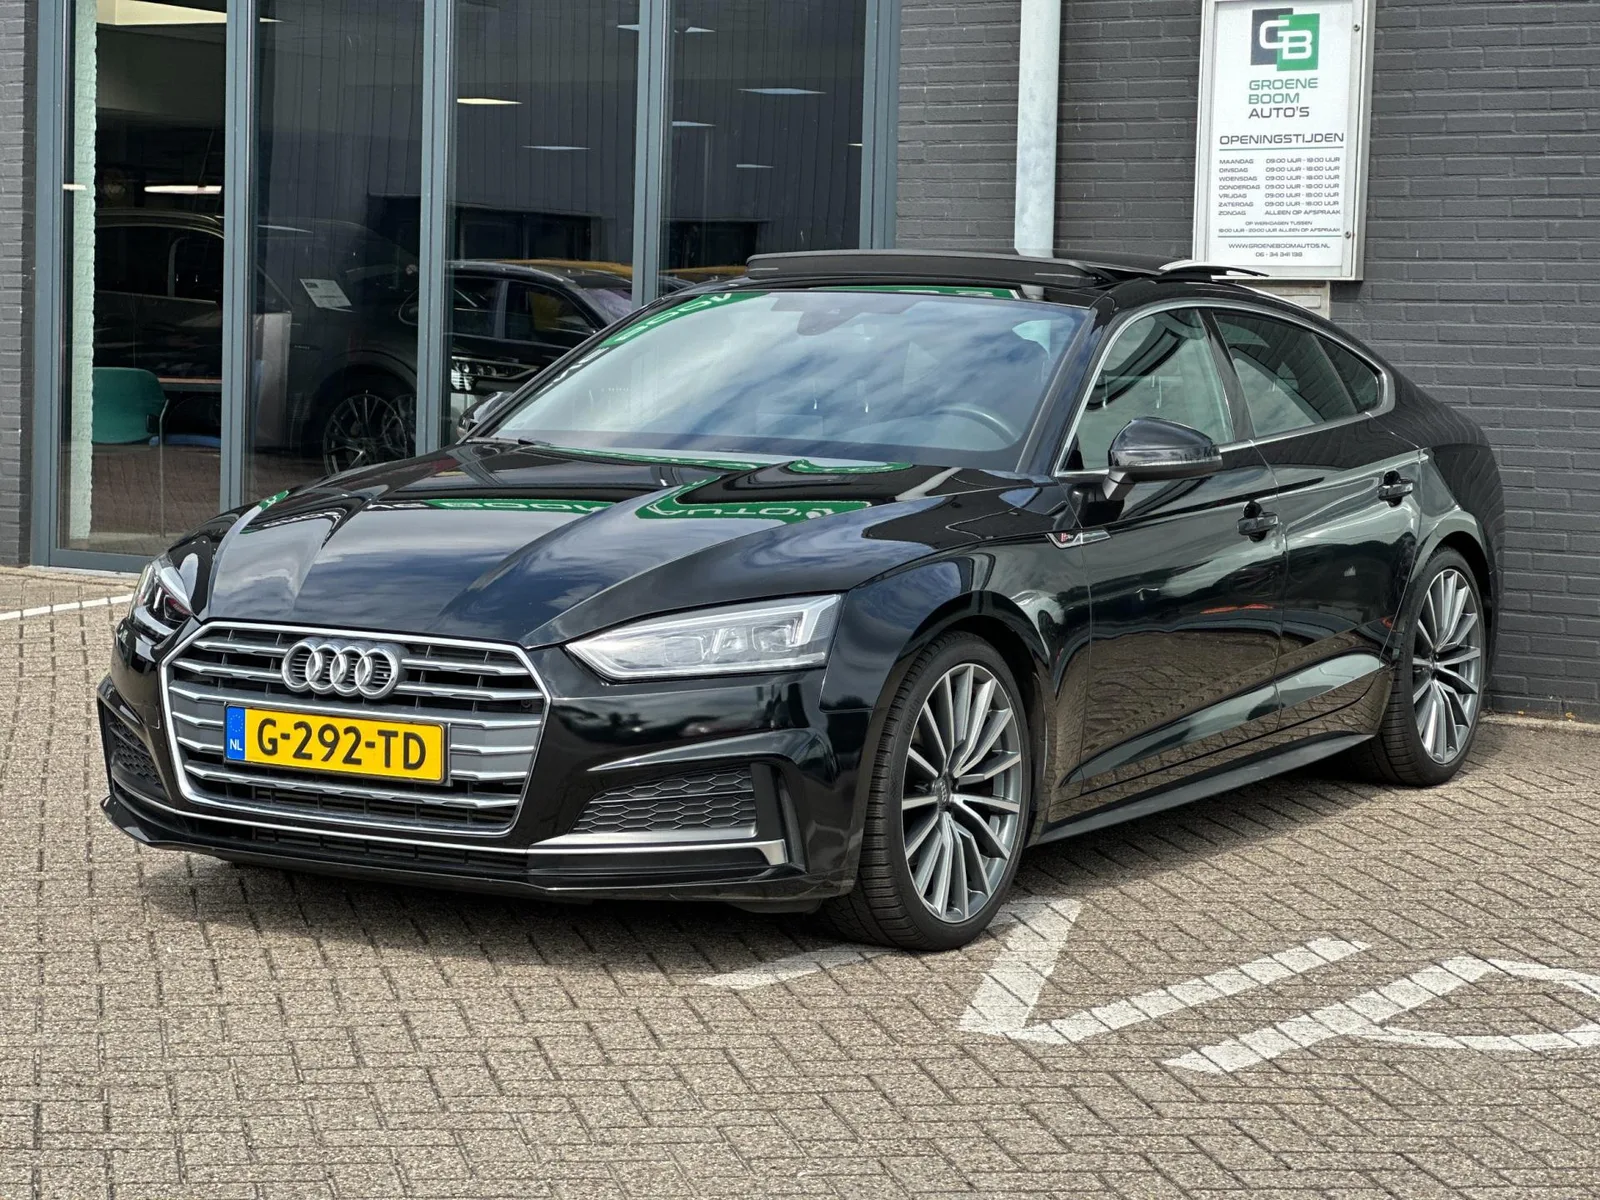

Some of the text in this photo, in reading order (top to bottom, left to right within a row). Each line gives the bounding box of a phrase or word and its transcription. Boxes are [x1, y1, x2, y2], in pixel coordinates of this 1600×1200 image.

[1248, 78, 1319, 91] GROENE
[1248, 92, 1300, 105] BOOM
[1248, 106, 1310, 119] AUTO'S
[1219, 132, 1345, 145] OPENINGSTIJDEN
[229, 738, 243, 751] NL
[257, 718, 426, 770] G-292-TD
